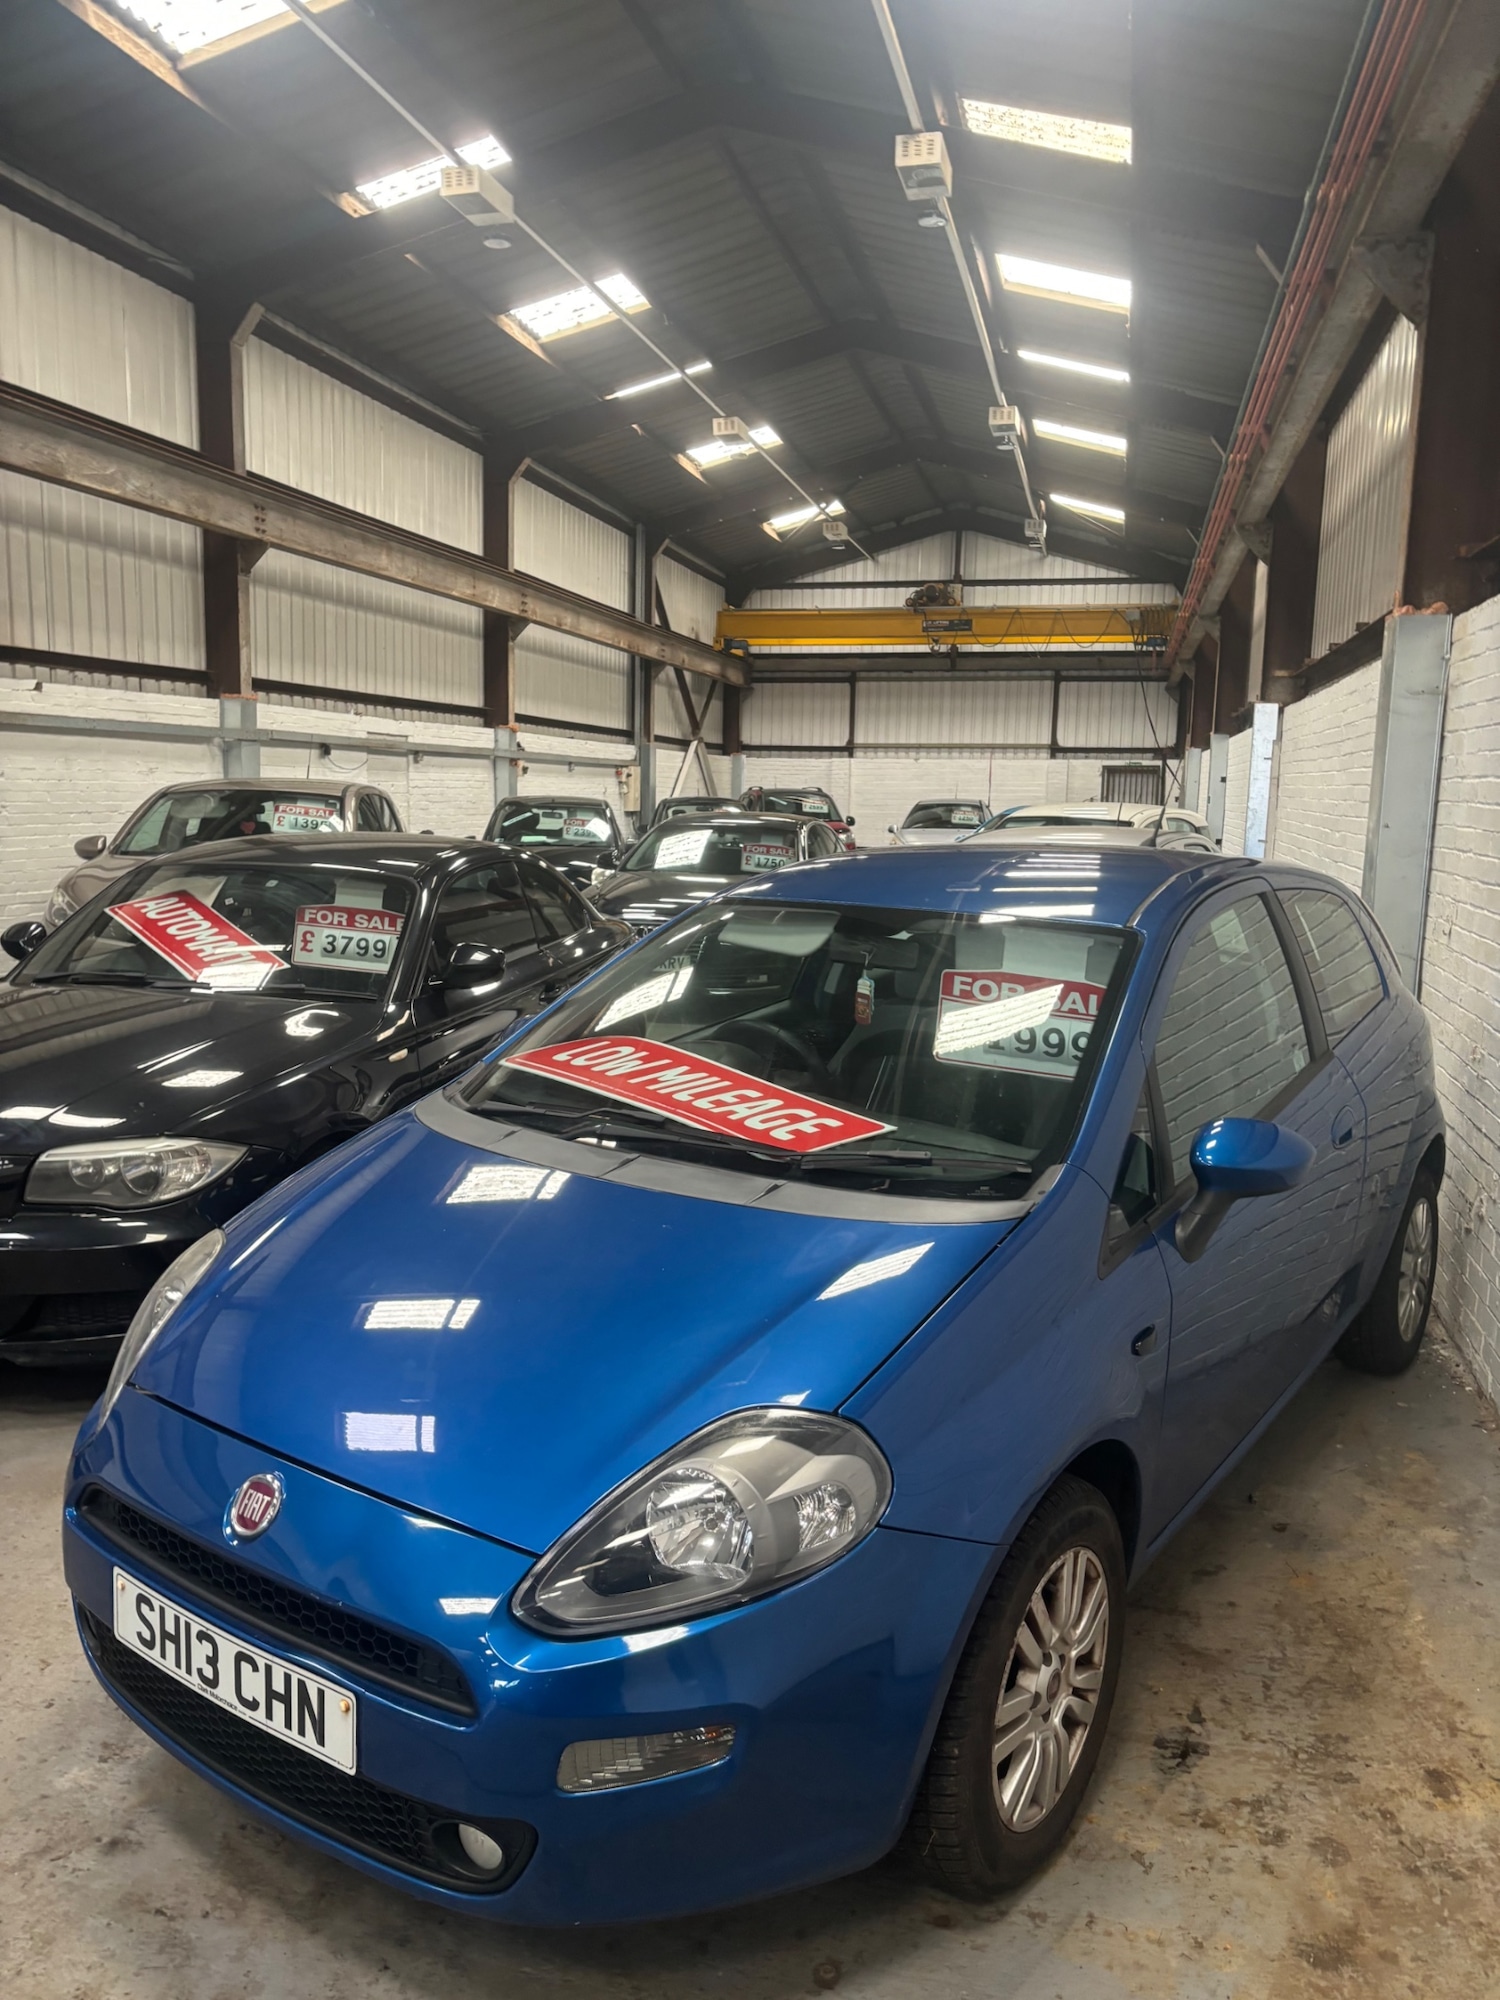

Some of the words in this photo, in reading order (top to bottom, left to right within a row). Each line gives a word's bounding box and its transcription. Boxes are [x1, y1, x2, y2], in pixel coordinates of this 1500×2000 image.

[277, 815, 285, 827] £
[279, 805, 304, 815] FOR
[744, 855, 752, 866] £
[756, 856, 786, 869] 1750
[746, 845, 767, 854] FOR
[769, 847, 795, 857] SALE
[304, 908, 348, 926] FOR
[354, 913, 405, 932] SALE
[133, 897, 263, 974] AUTOMATI
[300, 930, 315, 953] £
[322, 934, 387, 959] 3799
[552, 1040, 673, 1077] LOW
[627, 1065, 845, 1141] MILEAGE
[239, 1488, 271, 1523] FIAT
[135, 1592, 219, 1690] SH13
[234, 1650, 325, 1748] CHN
